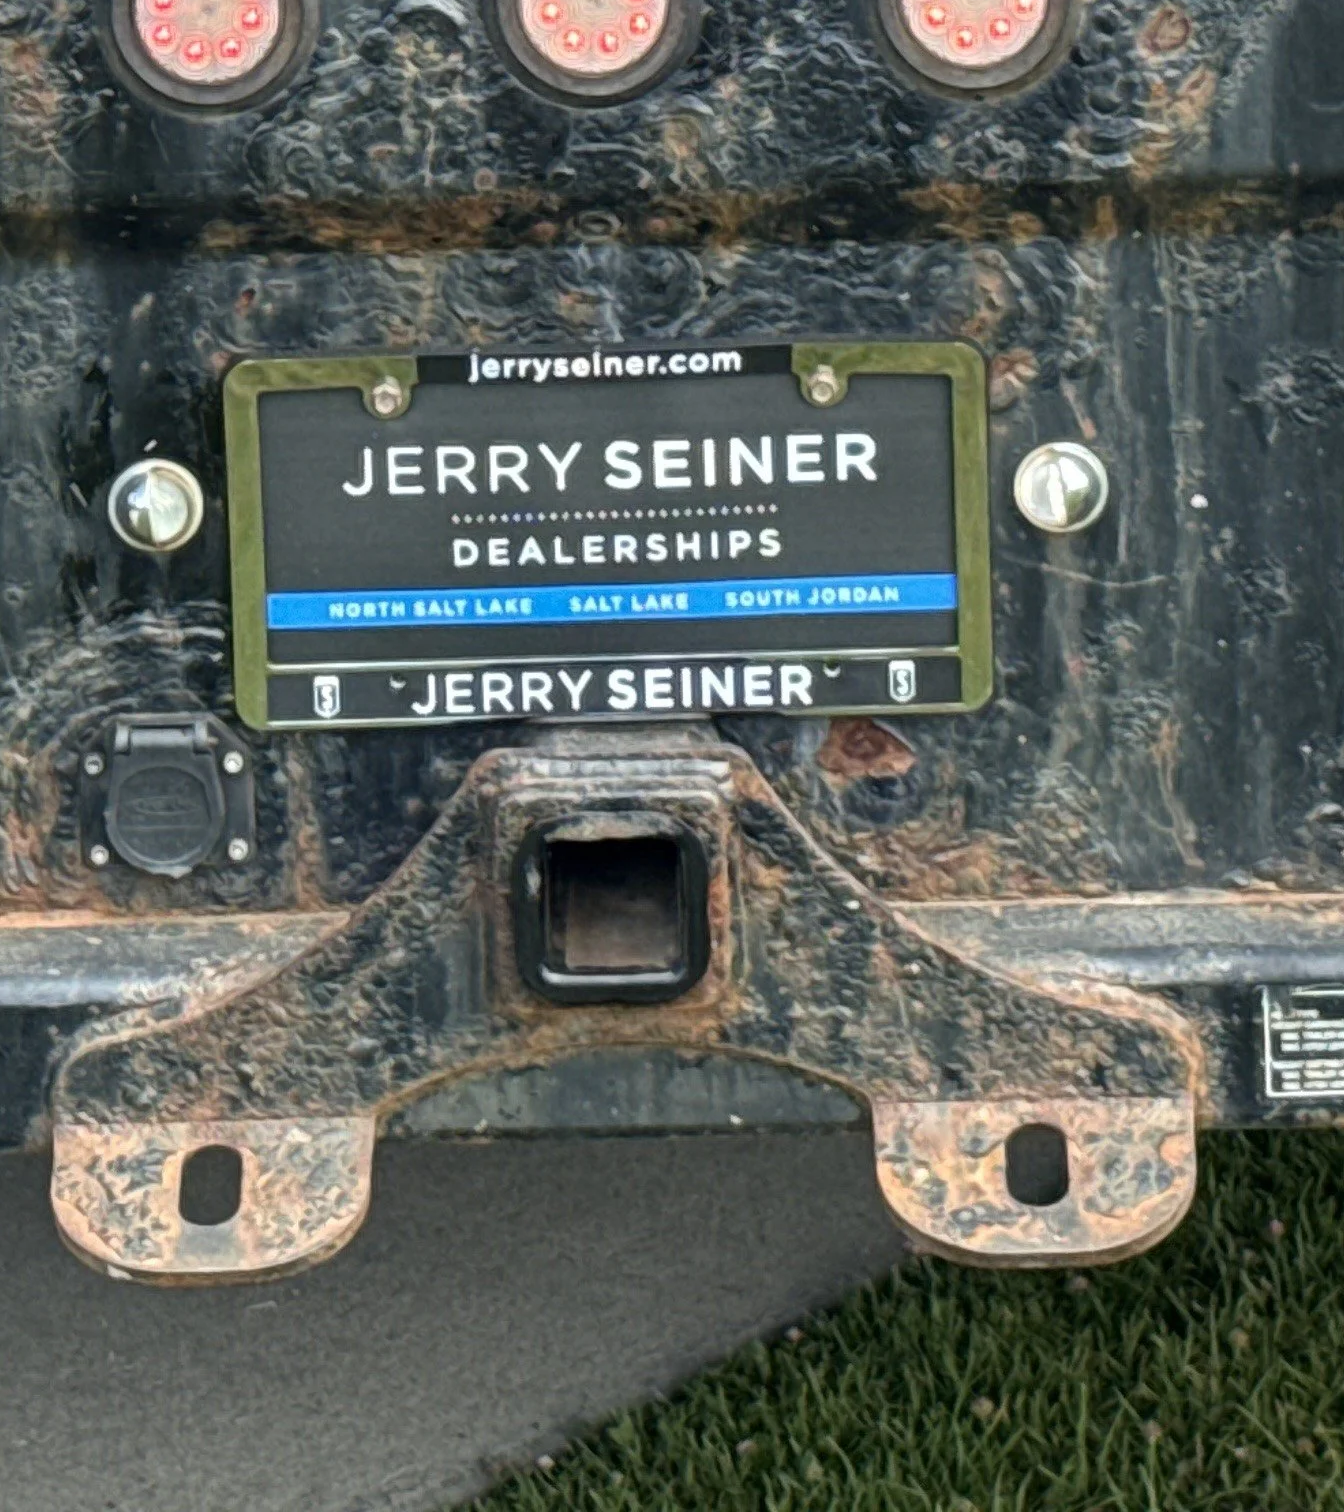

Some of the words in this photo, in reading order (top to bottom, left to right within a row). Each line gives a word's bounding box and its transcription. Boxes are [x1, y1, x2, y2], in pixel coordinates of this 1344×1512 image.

[468, 349, 742, 383] jerryseiner.com
[341, 441, 583, 498] JERRY
[603, 432, 878, 490] SEINER
[452, 527, 783, 567] DEALERSHIPS
[328, 601, 406, 619] NORTH
[412, 598, 467, 618] SALT
[474, 597, 533, 616] LAKE
[569, 595, 624, 613] SALT
[630, 592, 689, 612] LAKE
[724, 588, 800, 609] SOUTH
[807, 586, 900, 606] JORDAN
[411, 670, 594, 716] JERRY
[606, 665, 815, 712] SEINER
